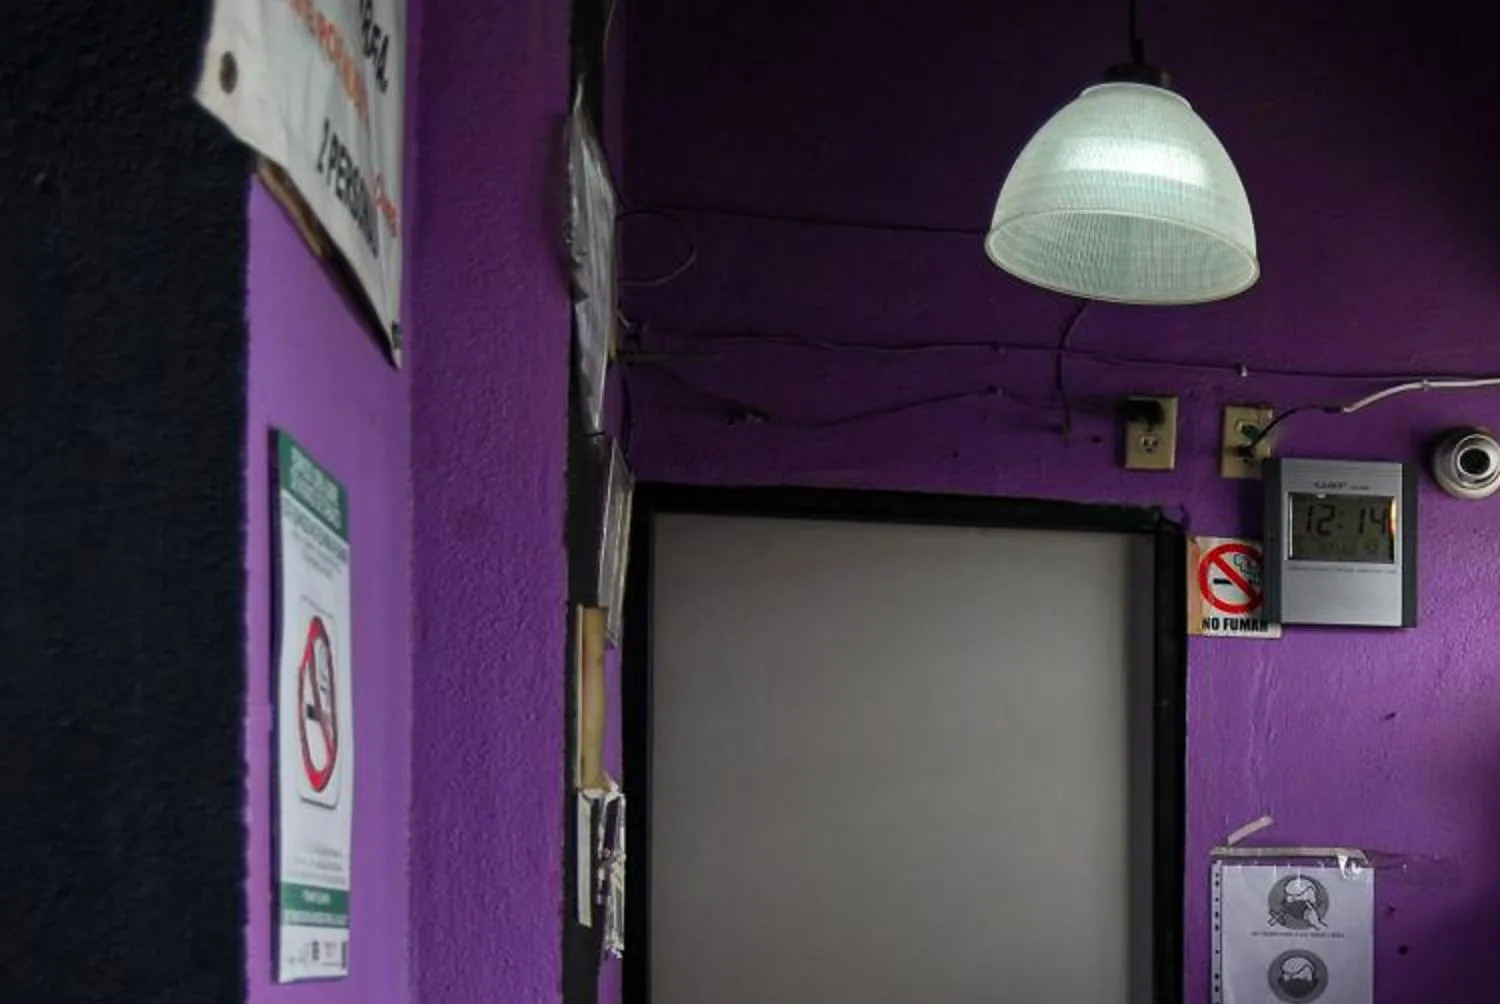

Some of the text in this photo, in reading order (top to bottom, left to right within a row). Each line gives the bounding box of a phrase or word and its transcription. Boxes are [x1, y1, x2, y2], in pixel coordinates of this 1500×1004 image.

[1305, 504, 1388, 536] 12:14
[1202, 616, 1269, 633] NO FUMAR
